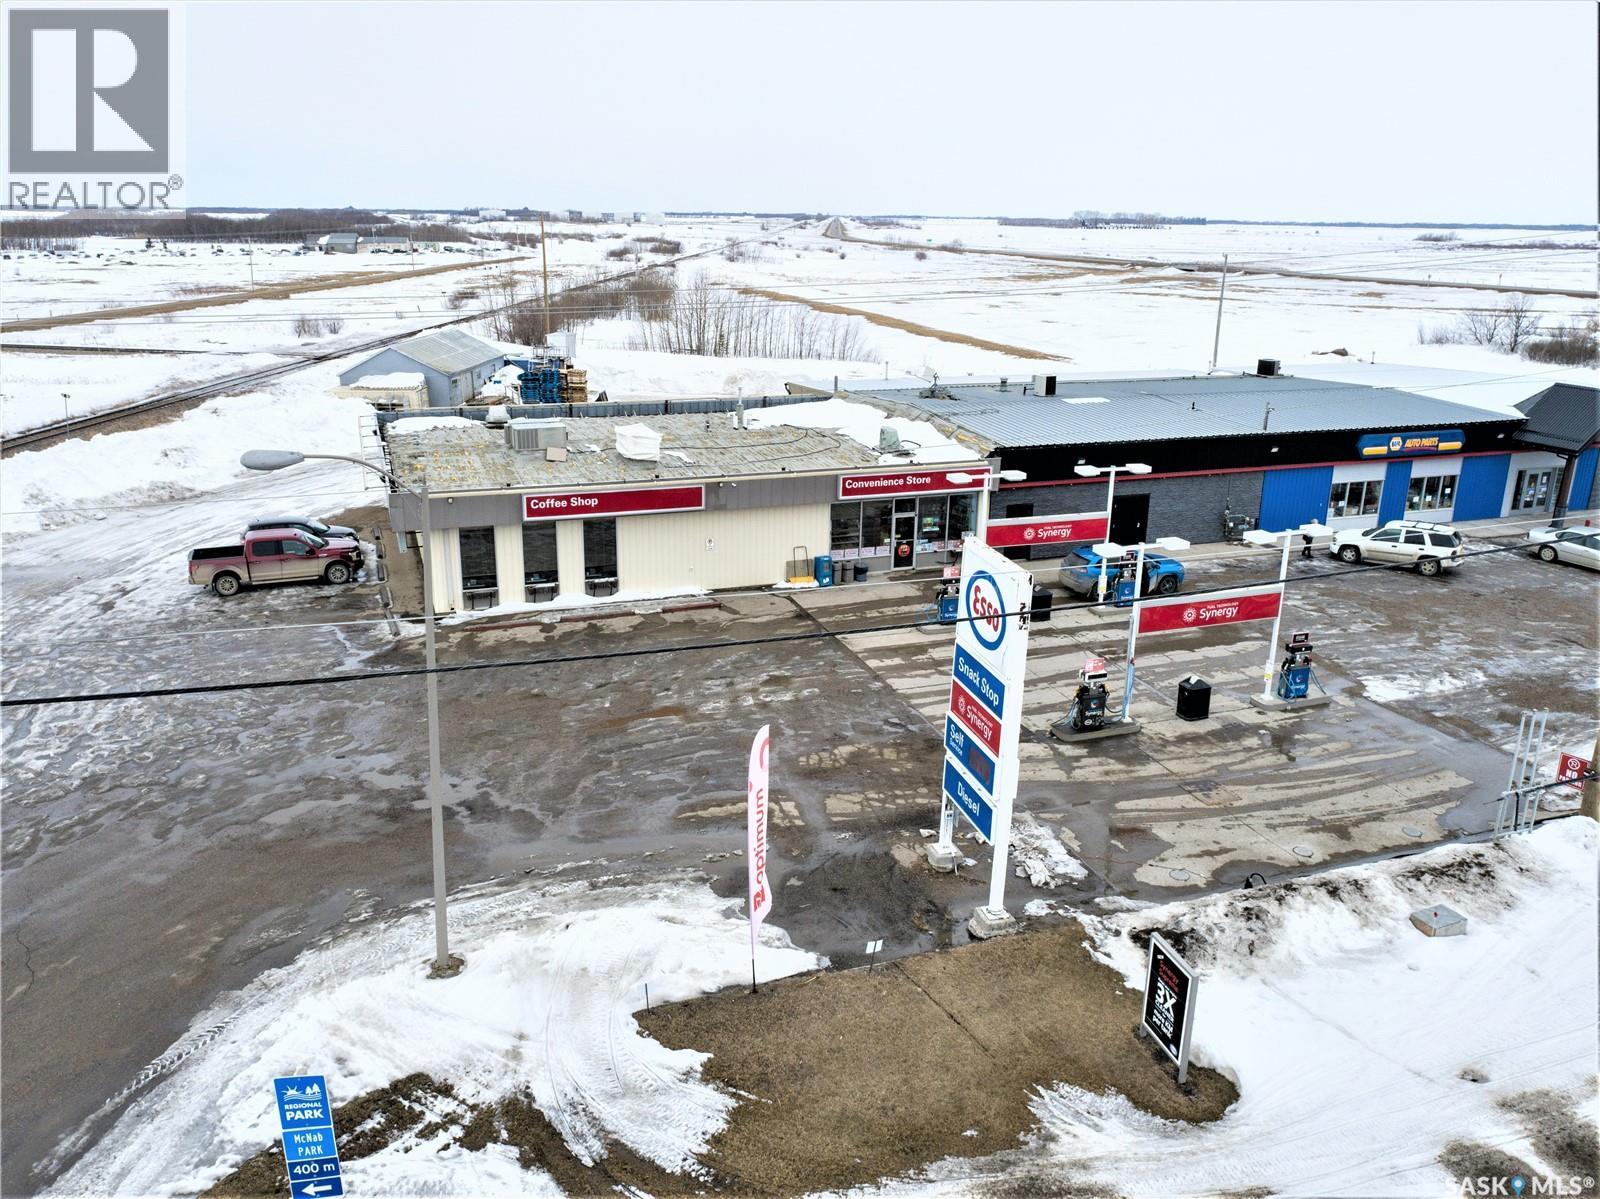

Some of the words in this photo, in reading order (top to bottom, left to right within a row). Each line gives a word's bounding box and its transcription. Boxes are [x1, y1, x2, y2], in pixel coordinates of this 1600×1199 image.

[845, 477, 904, 489] Convenience
[906, 475, 931, 485] Store
[530, 499, 568, 509] Coffee
[570, 497, 598, 508] Shop
[1037, 528, 1072, 540] Synergy
[1199, 606, 1239, 621] Synergy
[958, 656, 980, 688] Snack
[980, 677, 999, 707] Stop
[966, 705, 993, 741] Synergy
[950, 724, 964, 748] Self
[1565, 769, 1578, 780] NO
[957, 781, 980, 817] Diesel
[754, 788, 765, 885] optimum
[1155, 981, 1177, 1018] 3X
[284, 1102, 322, 1110] REGIONAL
[285, 1108, 324, 1121] PARK
[294, 1132, 323, 1144] McNab
[298, 1145, 323, 1157] PARK
[293, 1163, 319, 1175] 400
[323, 1163, 335, 1172] m
